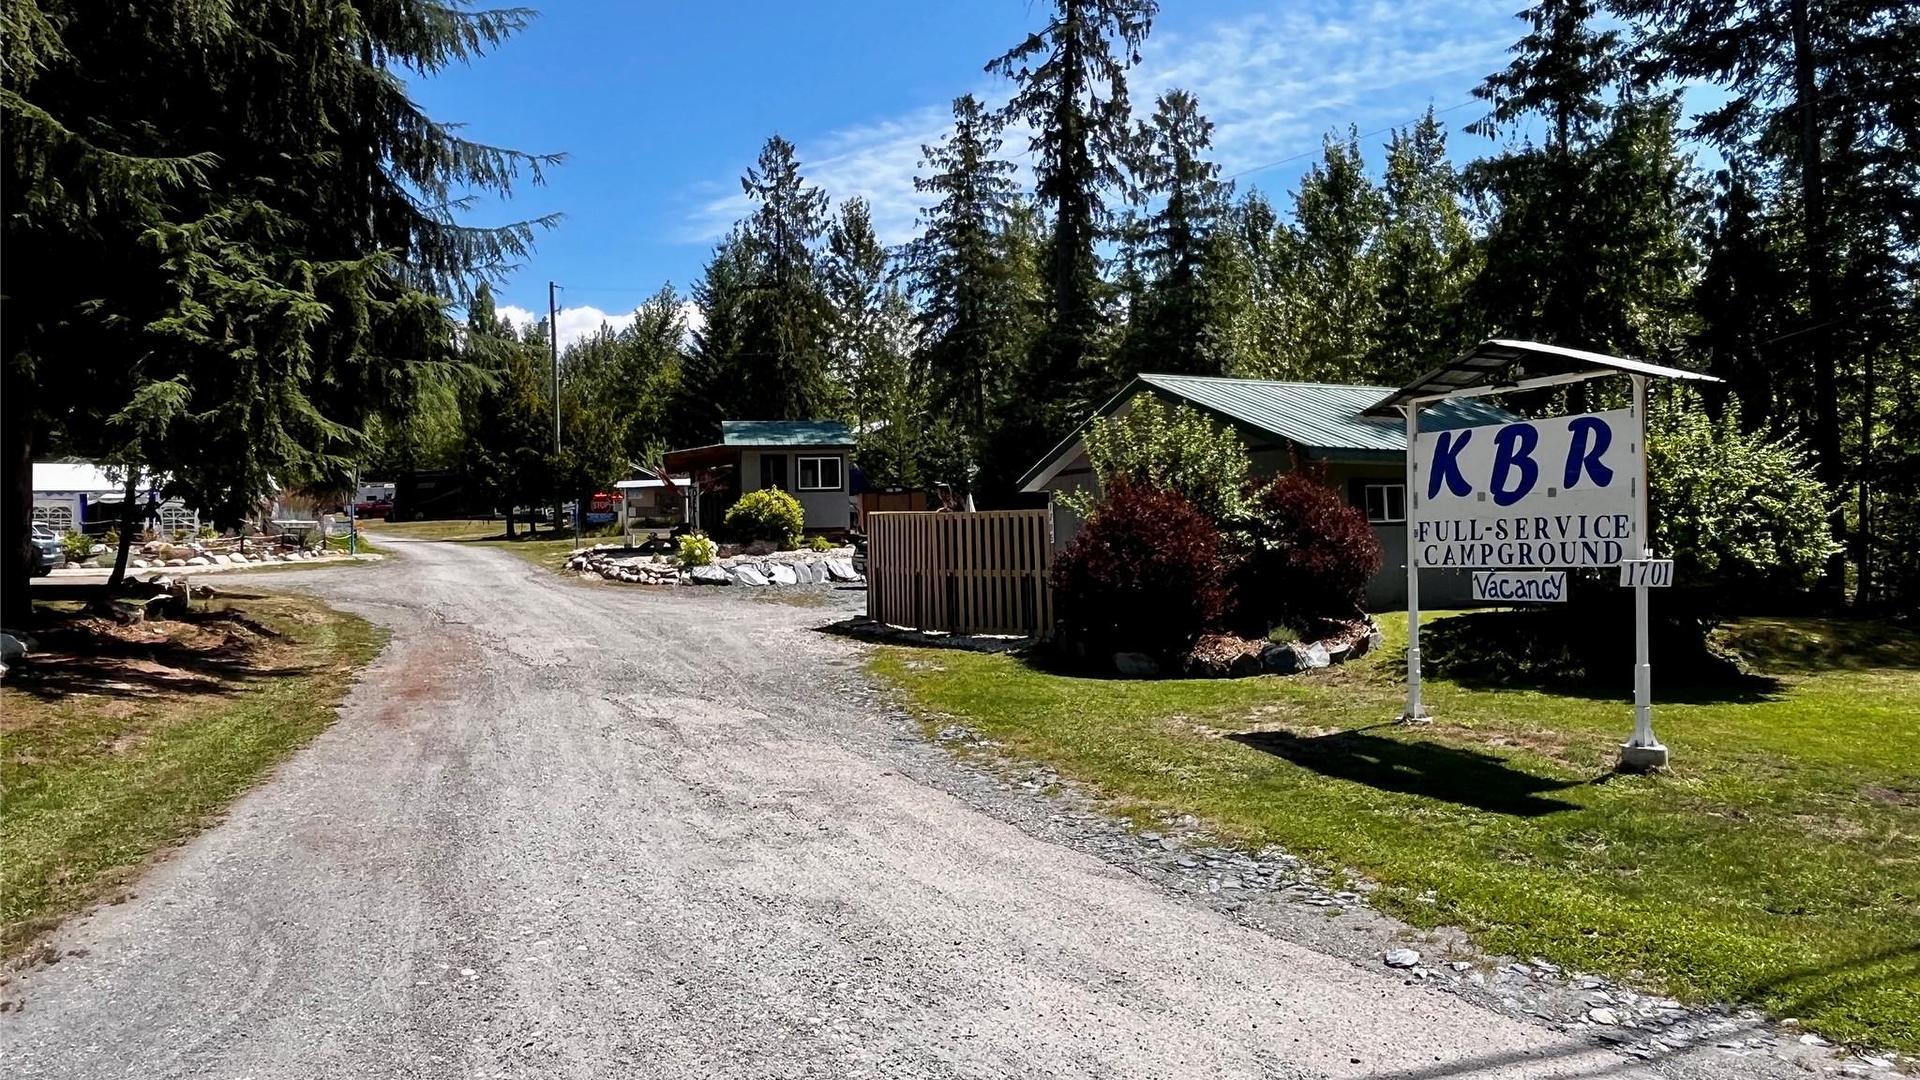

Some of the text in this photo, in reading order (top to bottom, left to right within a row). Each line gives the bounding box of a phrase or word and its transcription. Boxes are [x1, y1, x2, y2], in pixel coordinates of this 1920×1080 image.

[1418, 514, 1630, 542] FULL-SERVICE
[1424, 541, 1623, 566] CAMPGROUND
[1473, 572, 1566, 600] Vacancy
[1627, 561, 1670, 586] 1701
